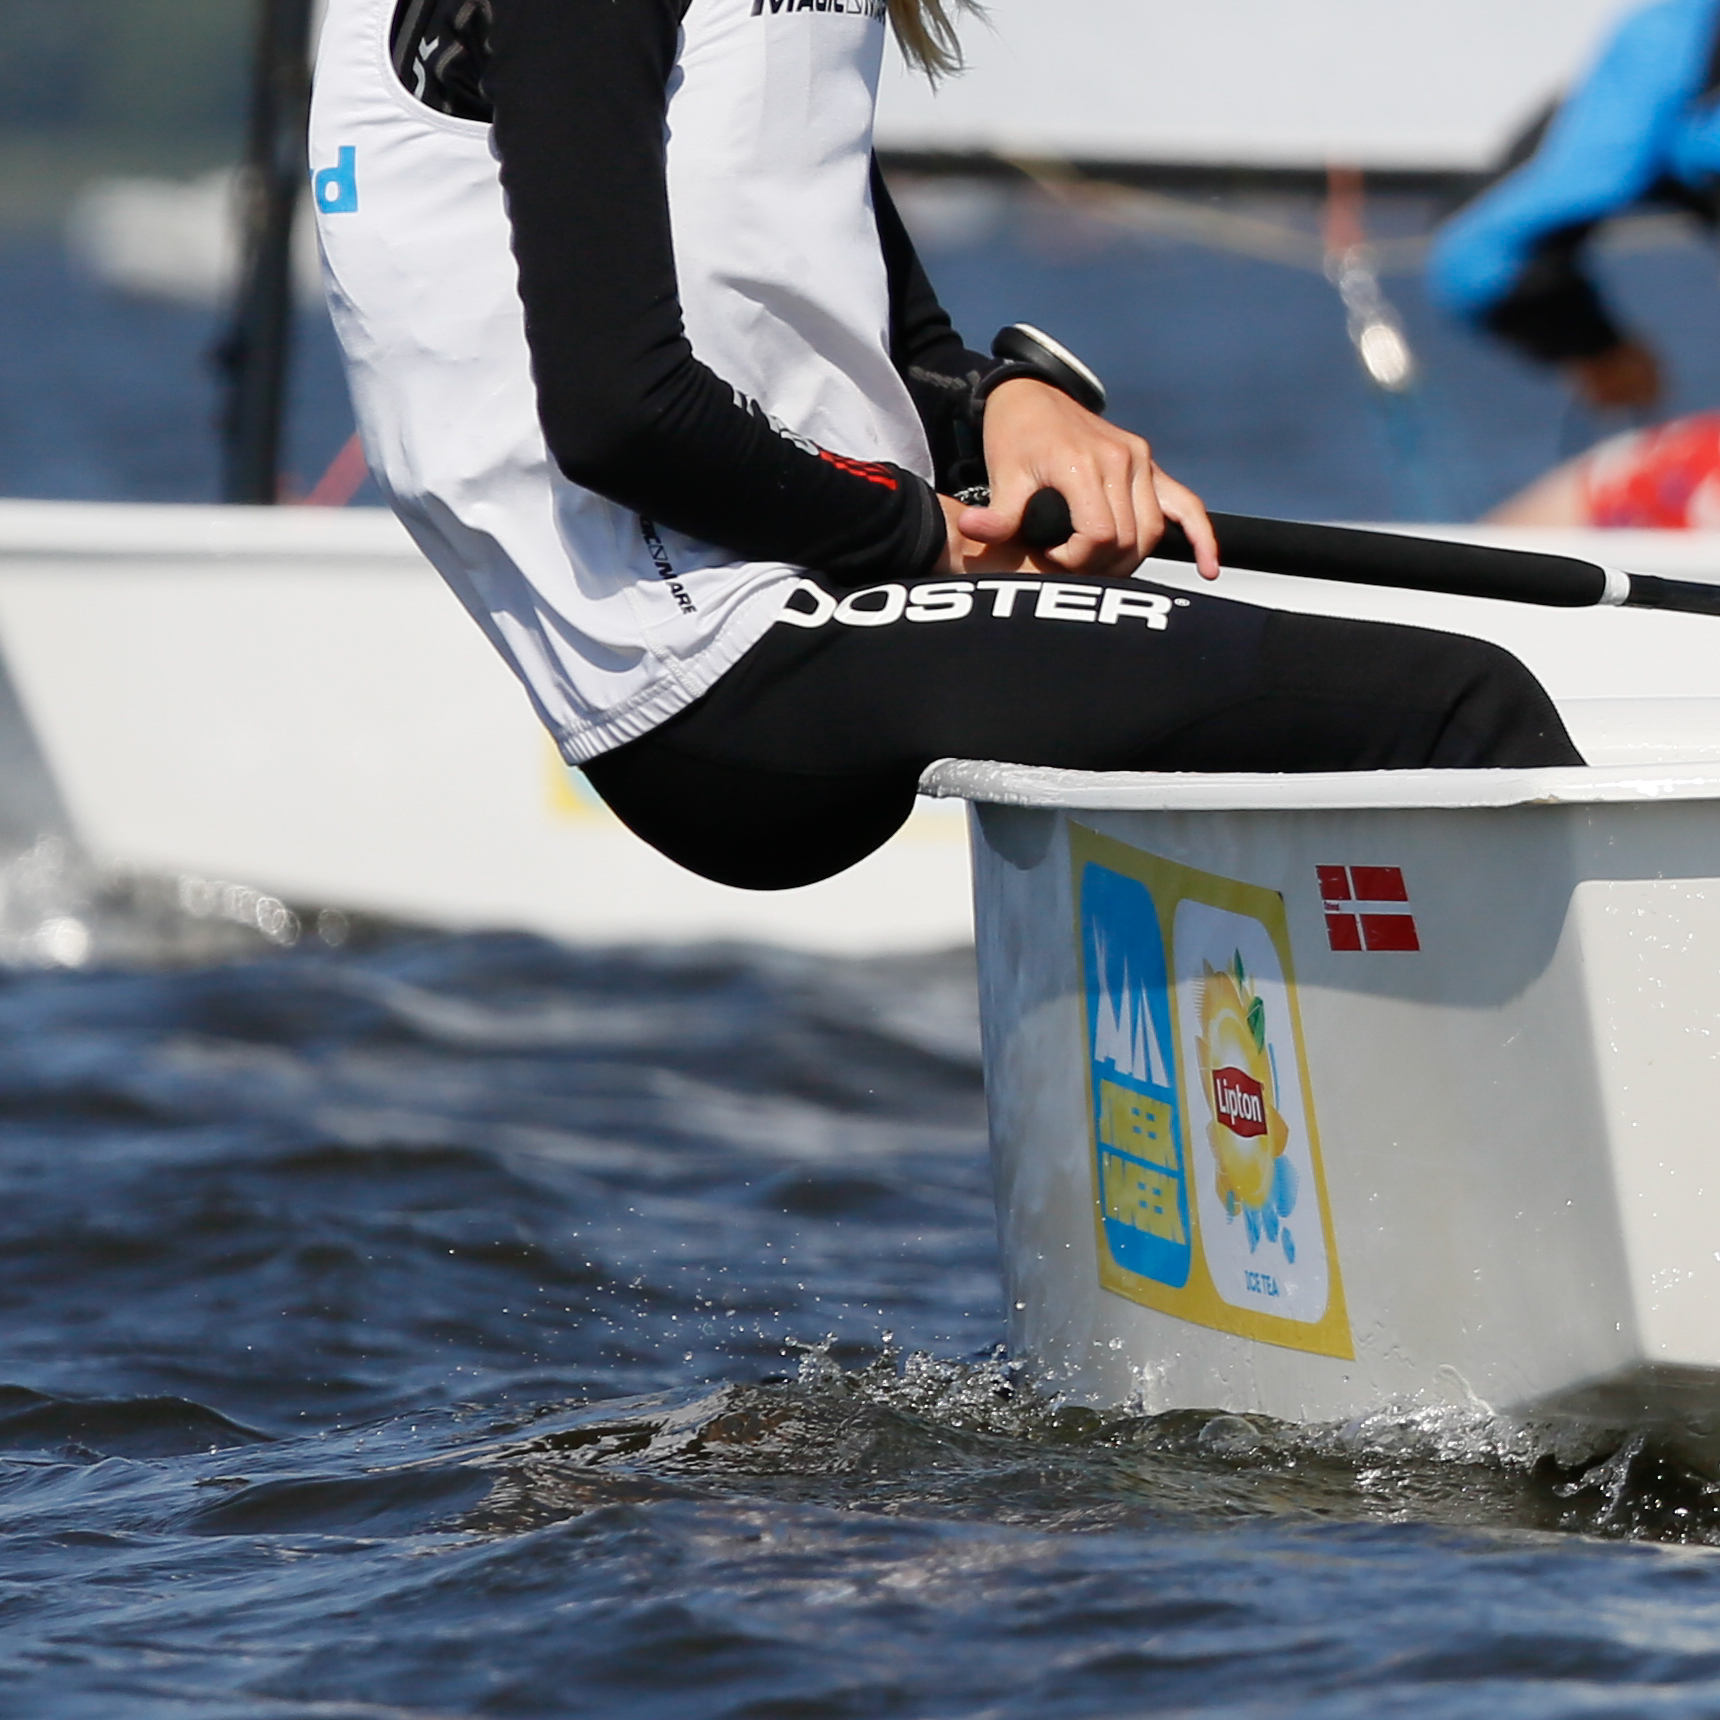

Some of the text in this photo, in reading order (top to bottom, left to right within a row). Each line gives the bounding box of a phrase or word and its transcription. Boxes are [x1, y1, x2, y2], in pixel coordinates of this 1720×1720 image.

[1216, 1077, 1262, 1126] Lipton
[1244, 1270, 1280, 1298] ICE TEA
